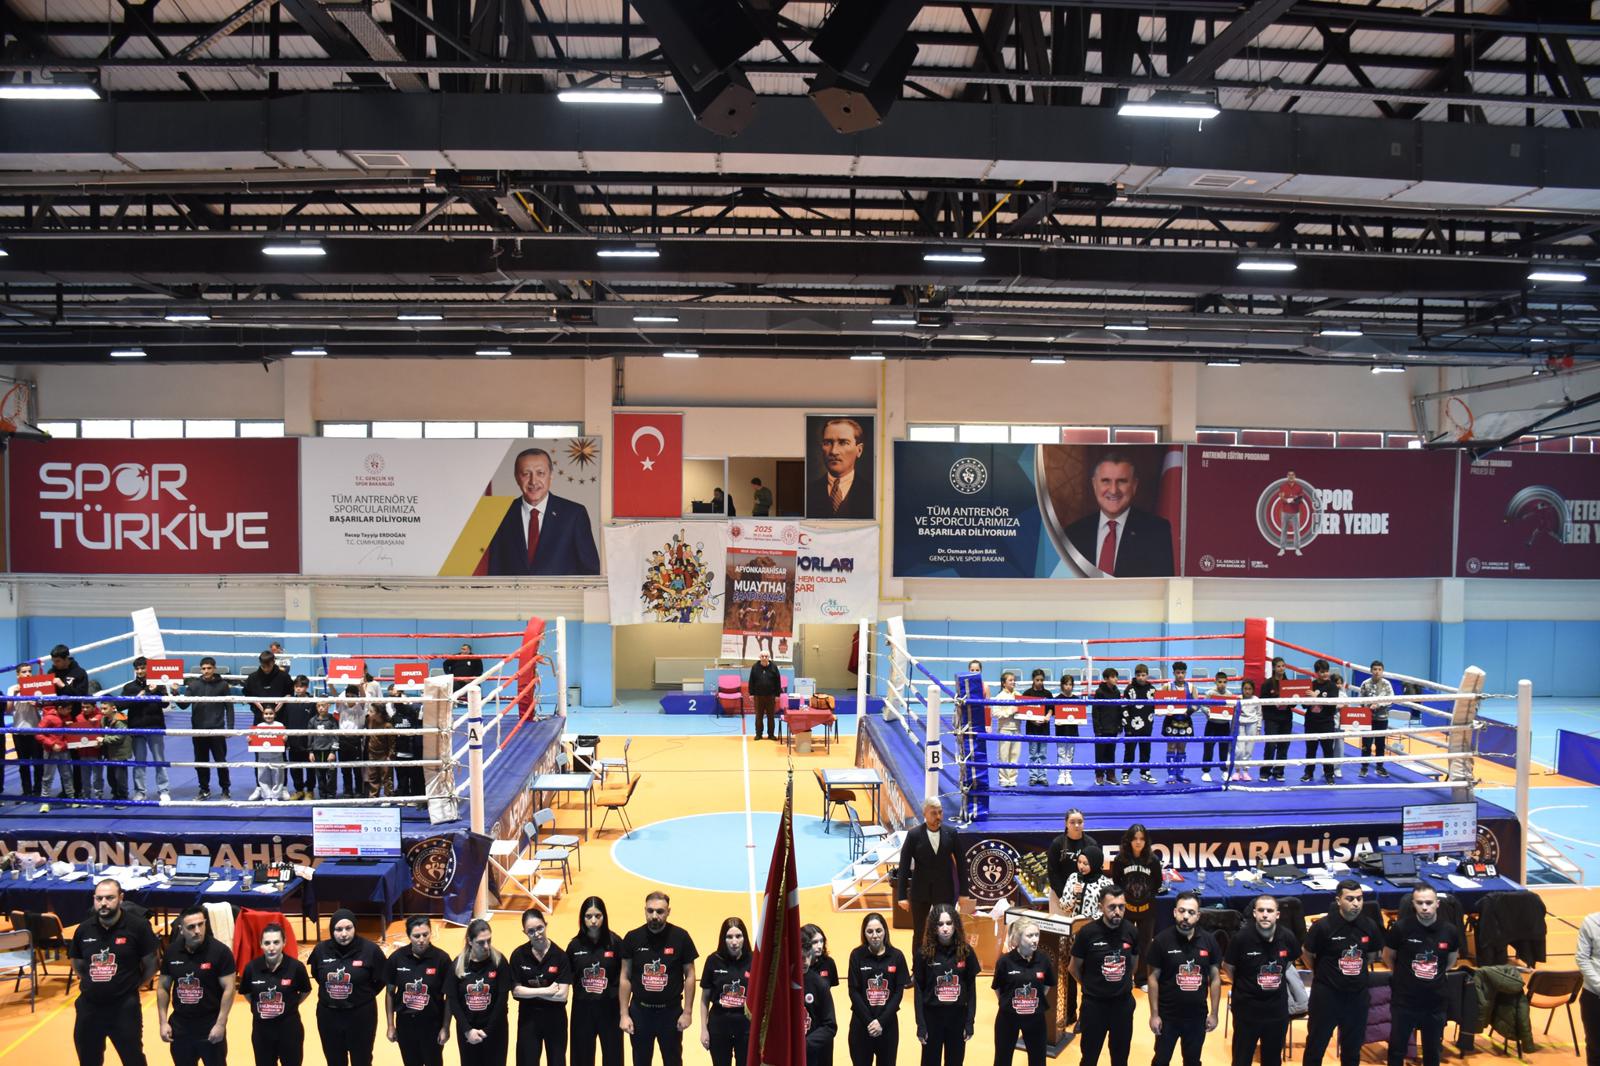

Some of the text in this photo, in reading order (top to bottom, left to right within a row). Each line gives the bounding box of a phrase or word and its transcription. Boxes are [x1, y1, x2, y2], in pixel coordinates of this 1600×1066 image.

[39, 462, 187, 501] SPOR
[331, 493, 419, 505] TÜM ANTRENÖR VE
[1312, 488, 1353, 511] SPOR
[334, 504, 416, 514] SPORCULARIMIZA
[927, 505, 1009, 517] TÜM ANTRENÖR
[329, 515, 421, 525] BAŞARILAR DİLİYORUM
[914, 516, 1021, 527] VE SPORCULARIMIZA
[1312, 512, 1389, 535] HER YERDE
[40, 503, 270, 550] TÜRKİYE
[753, 525, 773, 533] 2025
[918, 527, 1017, 538] BAŞARILAR DİLİYORUM
[929, 555, 955, 563] GENÇLİK
[735, 565, 786, 574] AFYONKARAHİSAR
[798, 575, 848, 584] HEM OKULDA
[734, 579, 787, 593] MUAYTHAI
[688, 699, 697, 711] 2
[468, 728, 479, 742] A
[931, 750, 940, 764] B
